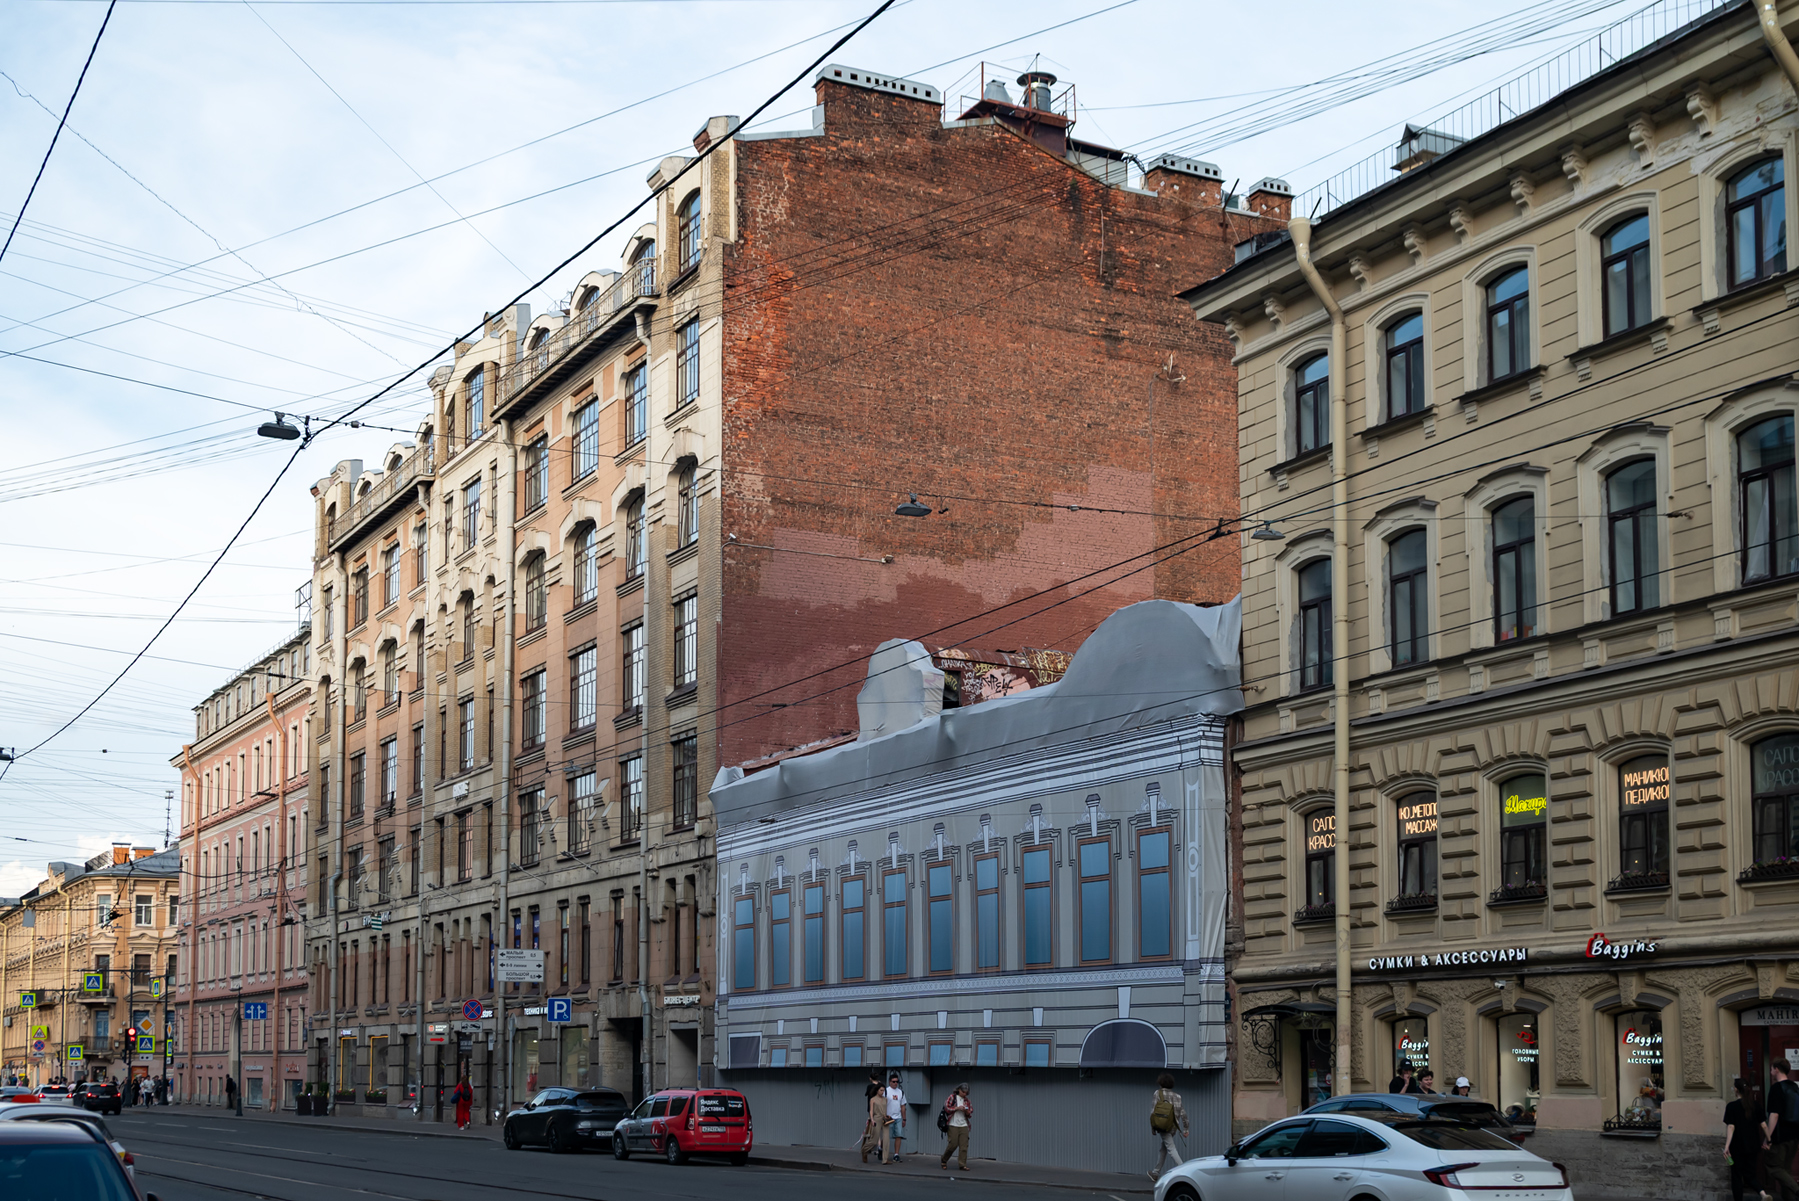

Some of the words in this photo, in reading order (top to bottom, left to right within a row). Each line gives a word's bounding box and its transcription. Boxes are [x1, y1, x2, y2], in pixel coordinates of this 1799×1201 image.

[1405, 818, 1438, 835] МАССАЖ
[1591, 939, 1656, 959] Baggins
[1369, 955, 1413, 970] СУМКИ
[1421, 955, 1429, 966] &
[1435, 948, 1526, 965] АКСЕССУАРЫ
[1757, 1010, 1799, 1020] MAHIR
